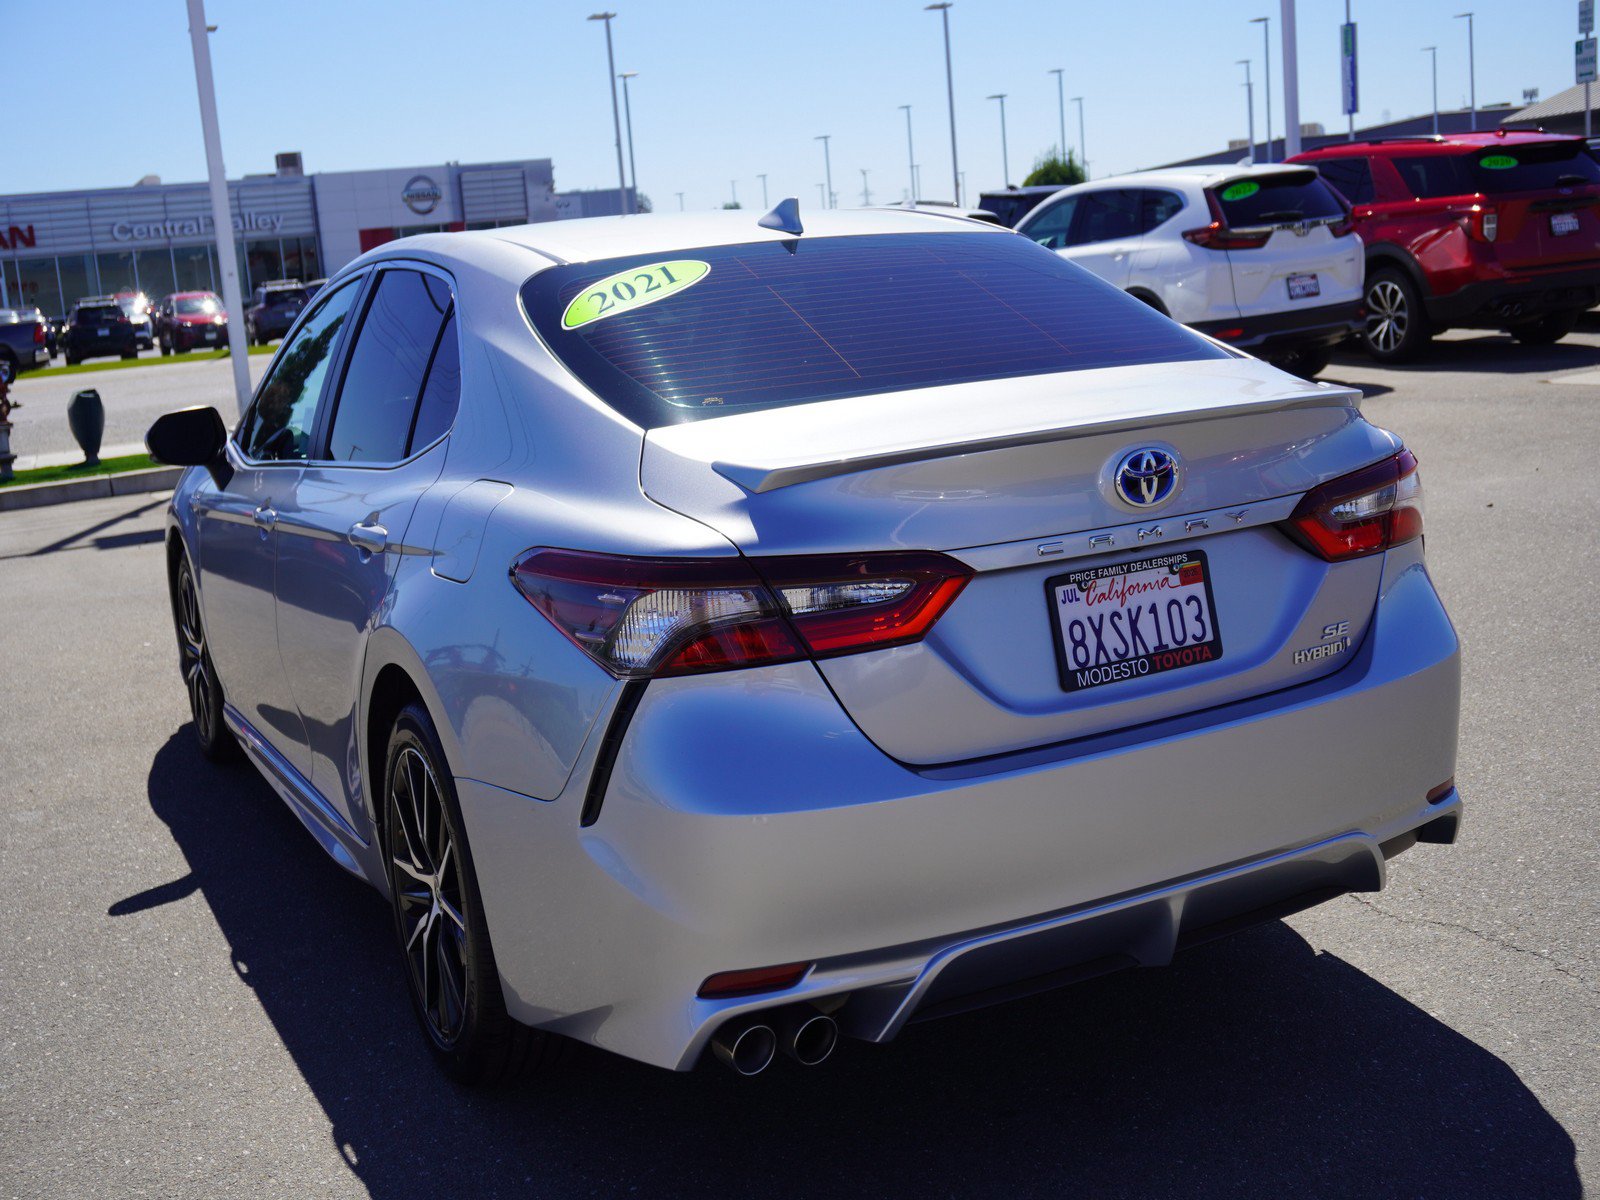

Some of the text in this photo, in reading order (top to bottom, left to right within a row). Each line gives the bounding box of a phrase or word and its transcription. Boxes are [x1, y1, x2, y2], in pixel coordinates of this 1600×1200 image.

[112, 211, 284, 241] Central alley
[587, 266, 681, 314] 2021
[1037, 509, 1249, 556] CAMRY
[1069, 553, 1188, 583] PRICE FAMILY DEALERSHIPS
[1061, 587, 1080, 604] JUL
[1085, 575, 1178, 607] California
[1068, 595, 1207, 668] 8XSK103
[1321, 620, 1350, 640] SE
[1076, 645, 1213, 687] MODESTO TOYOTA
[1293, 641, 1343, 665] HYBRID
